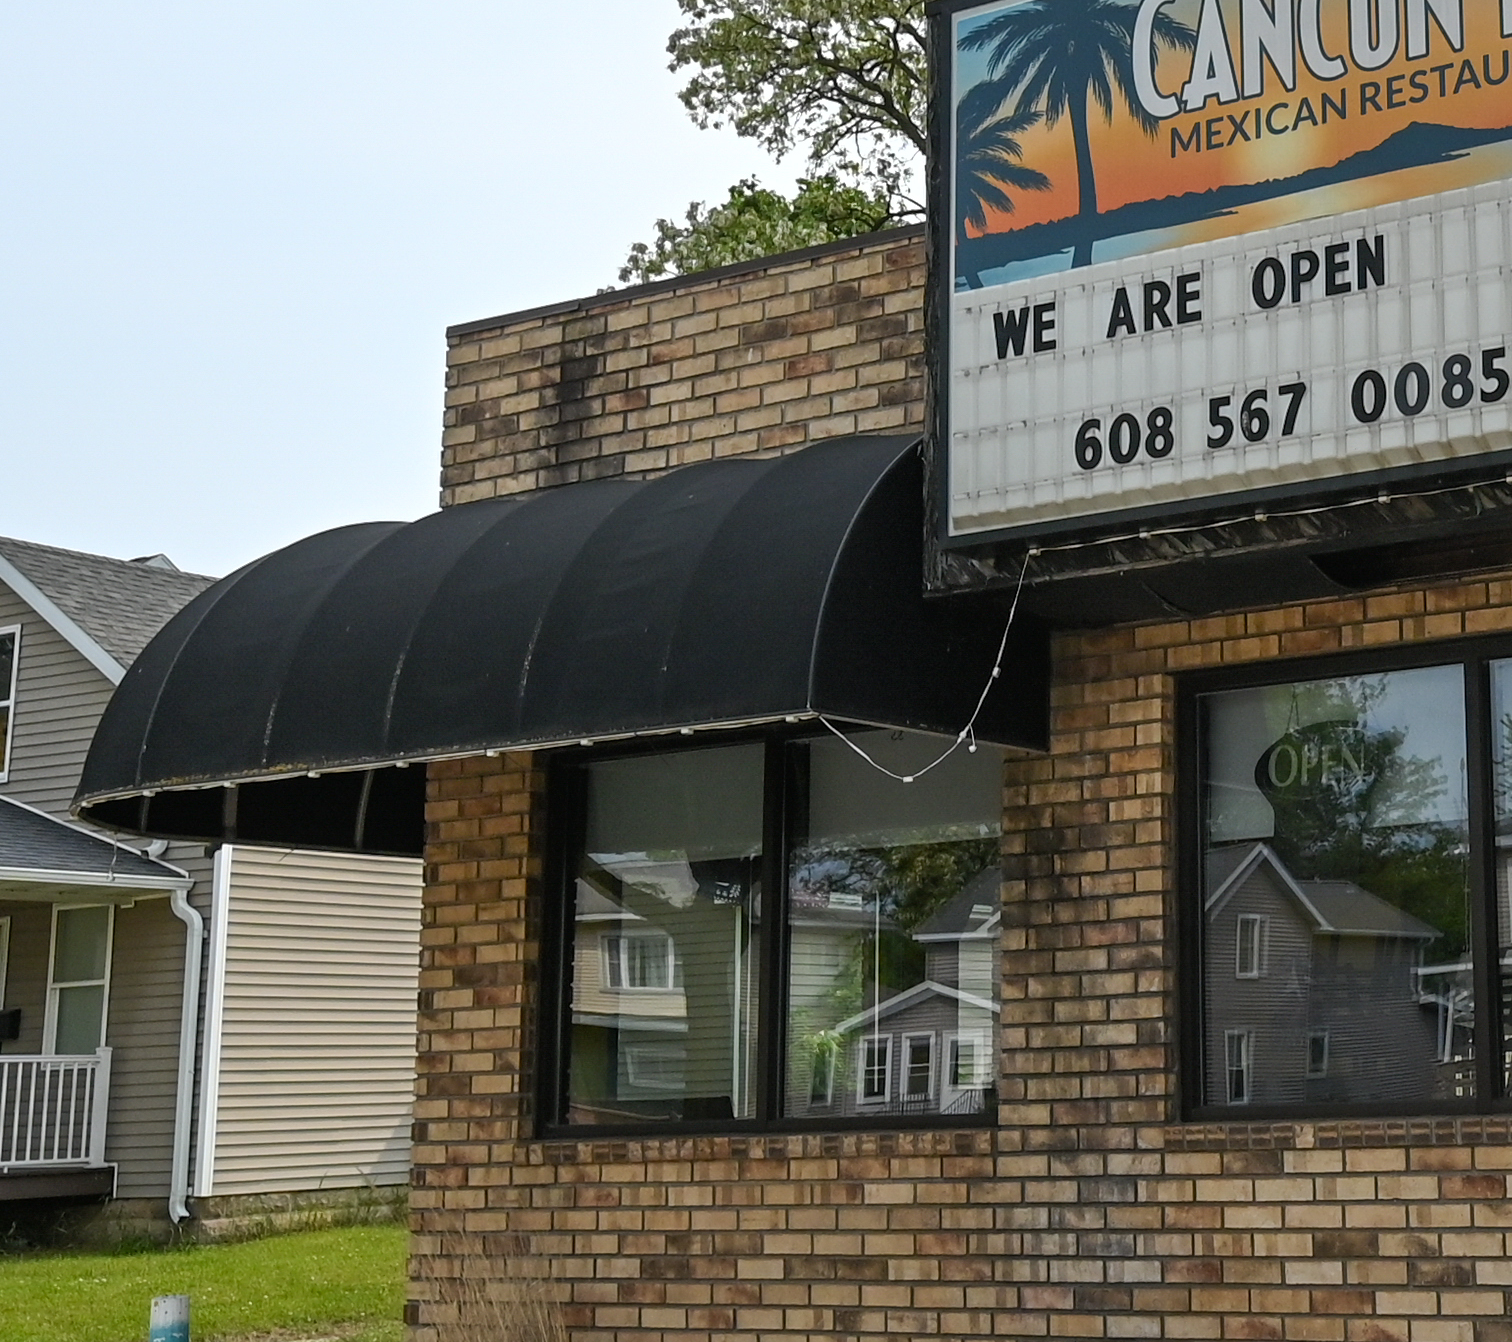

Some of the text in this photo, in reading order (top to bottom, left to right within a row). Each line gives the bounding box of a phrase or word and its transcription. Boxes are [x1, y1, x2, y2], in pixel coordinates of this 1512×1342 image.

[1169, 86, 1349, 157] MEXICAN
[993, 236, 1386, 359] WE ARE OPEN
[1074, 347, 1511, 470] 608 567 0085
[1268, 743, 1365, 787] OPEN
